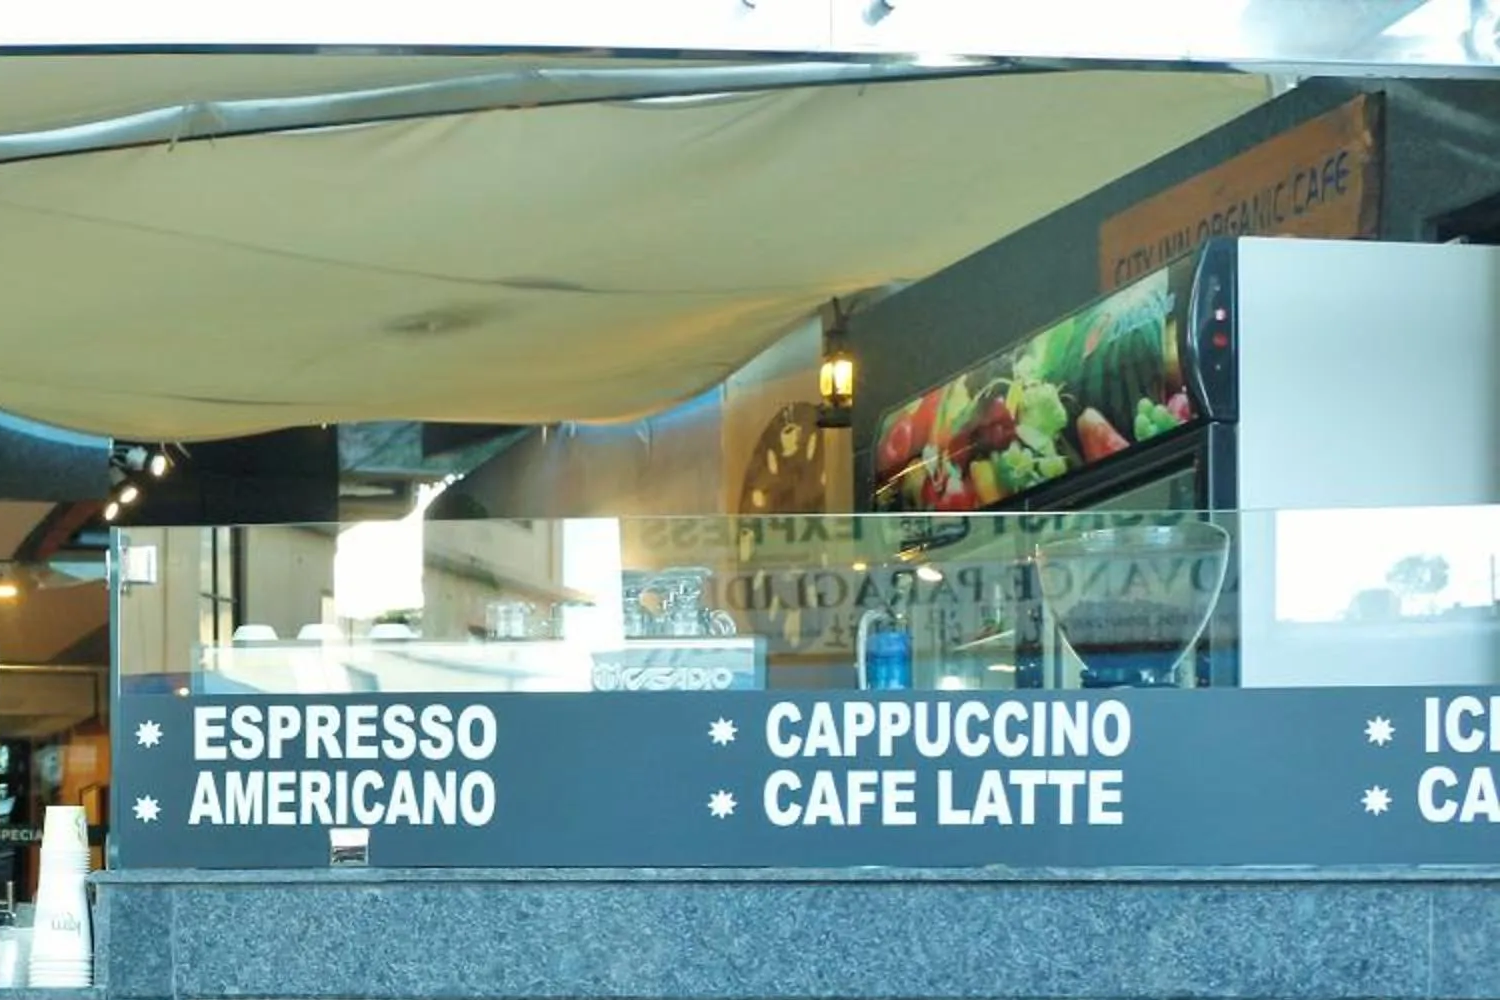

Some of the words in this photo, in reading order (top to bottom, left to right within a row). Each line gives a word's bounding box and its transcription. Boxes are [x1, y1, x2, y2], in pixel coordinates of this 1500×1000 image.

[1114, 243, 1157, 287] CITY
[1197, 182, 1286, 243] ORGANIC
[1293, 150, 1350, 215] CAFE
[195, 705, 496, 760] ESPRESSO
[767, 700, 1131, 757] CAPPUCCINO
[189, 770, 495, 826] AMERICANO
[764, 770, 916, 826] CAFE
[938, 770, 1122, 825] LATTE
